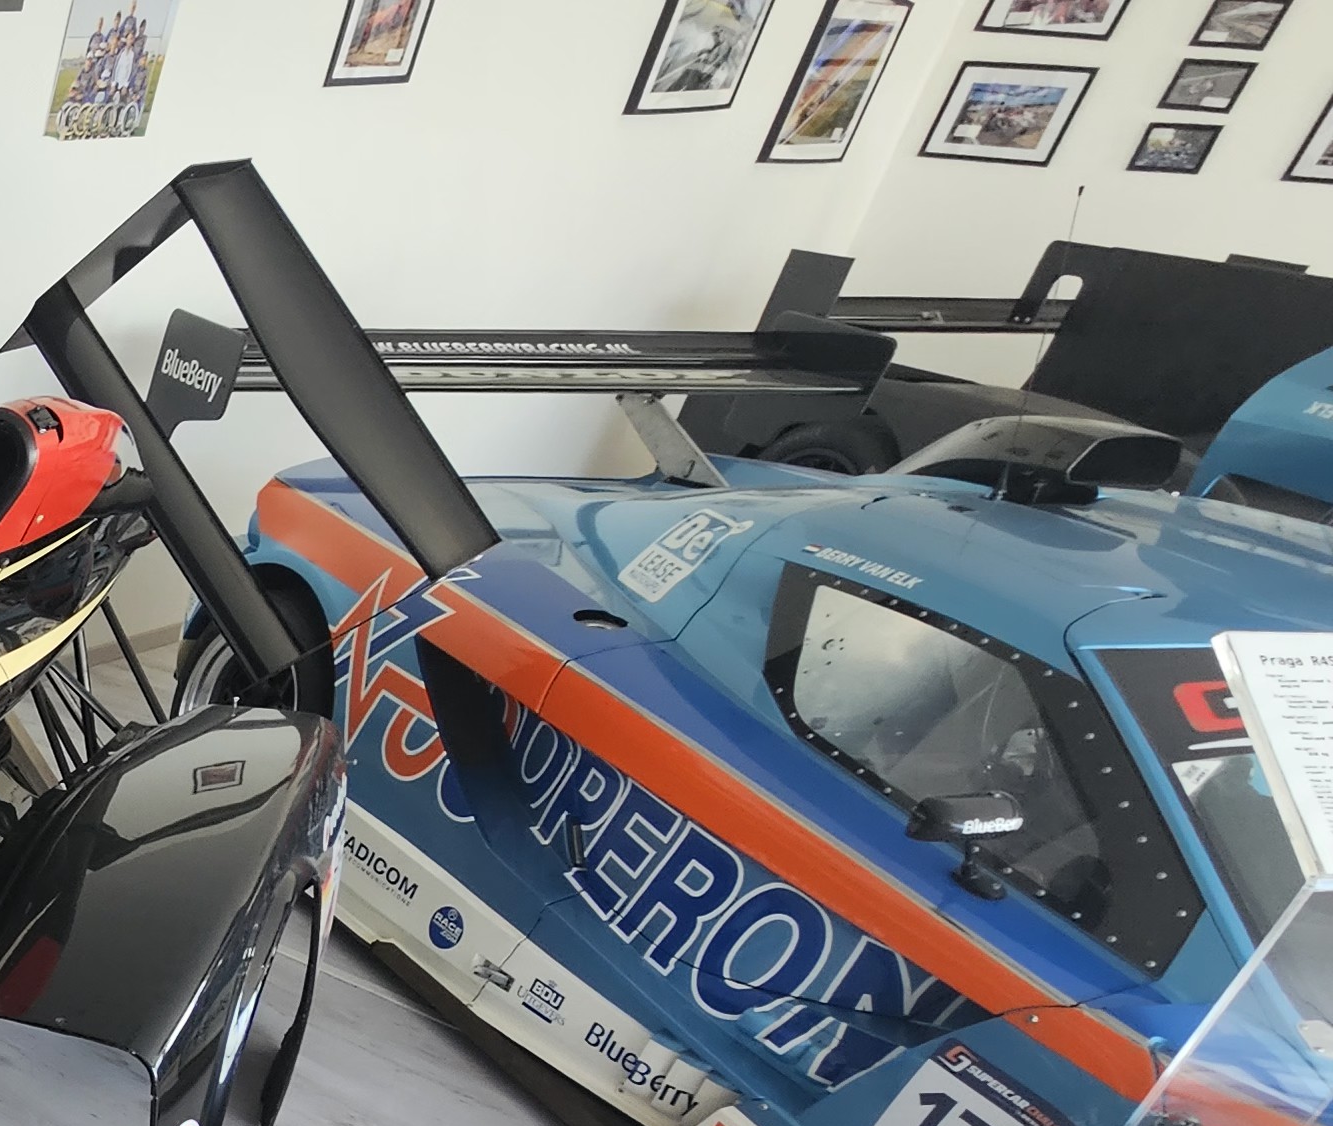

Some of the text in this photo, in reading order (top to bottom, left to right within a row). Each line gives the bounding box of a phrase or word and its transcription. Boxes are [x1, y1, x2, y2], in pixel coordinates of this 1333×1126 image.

[161, 348, 223, 403] BlueBerry
[637, 550, 683, 583] LEASE
[859, 559, 896, 579] VAN
[1259, 655, 1303, 668] Praga
[343, 829, 419, 900] ADICOM
[531, 980, 564, 1009] BDU
[584, 1021, 700, 1117] BlueBerry
[965, 1065, 1031, 1110] SUPERCAR
